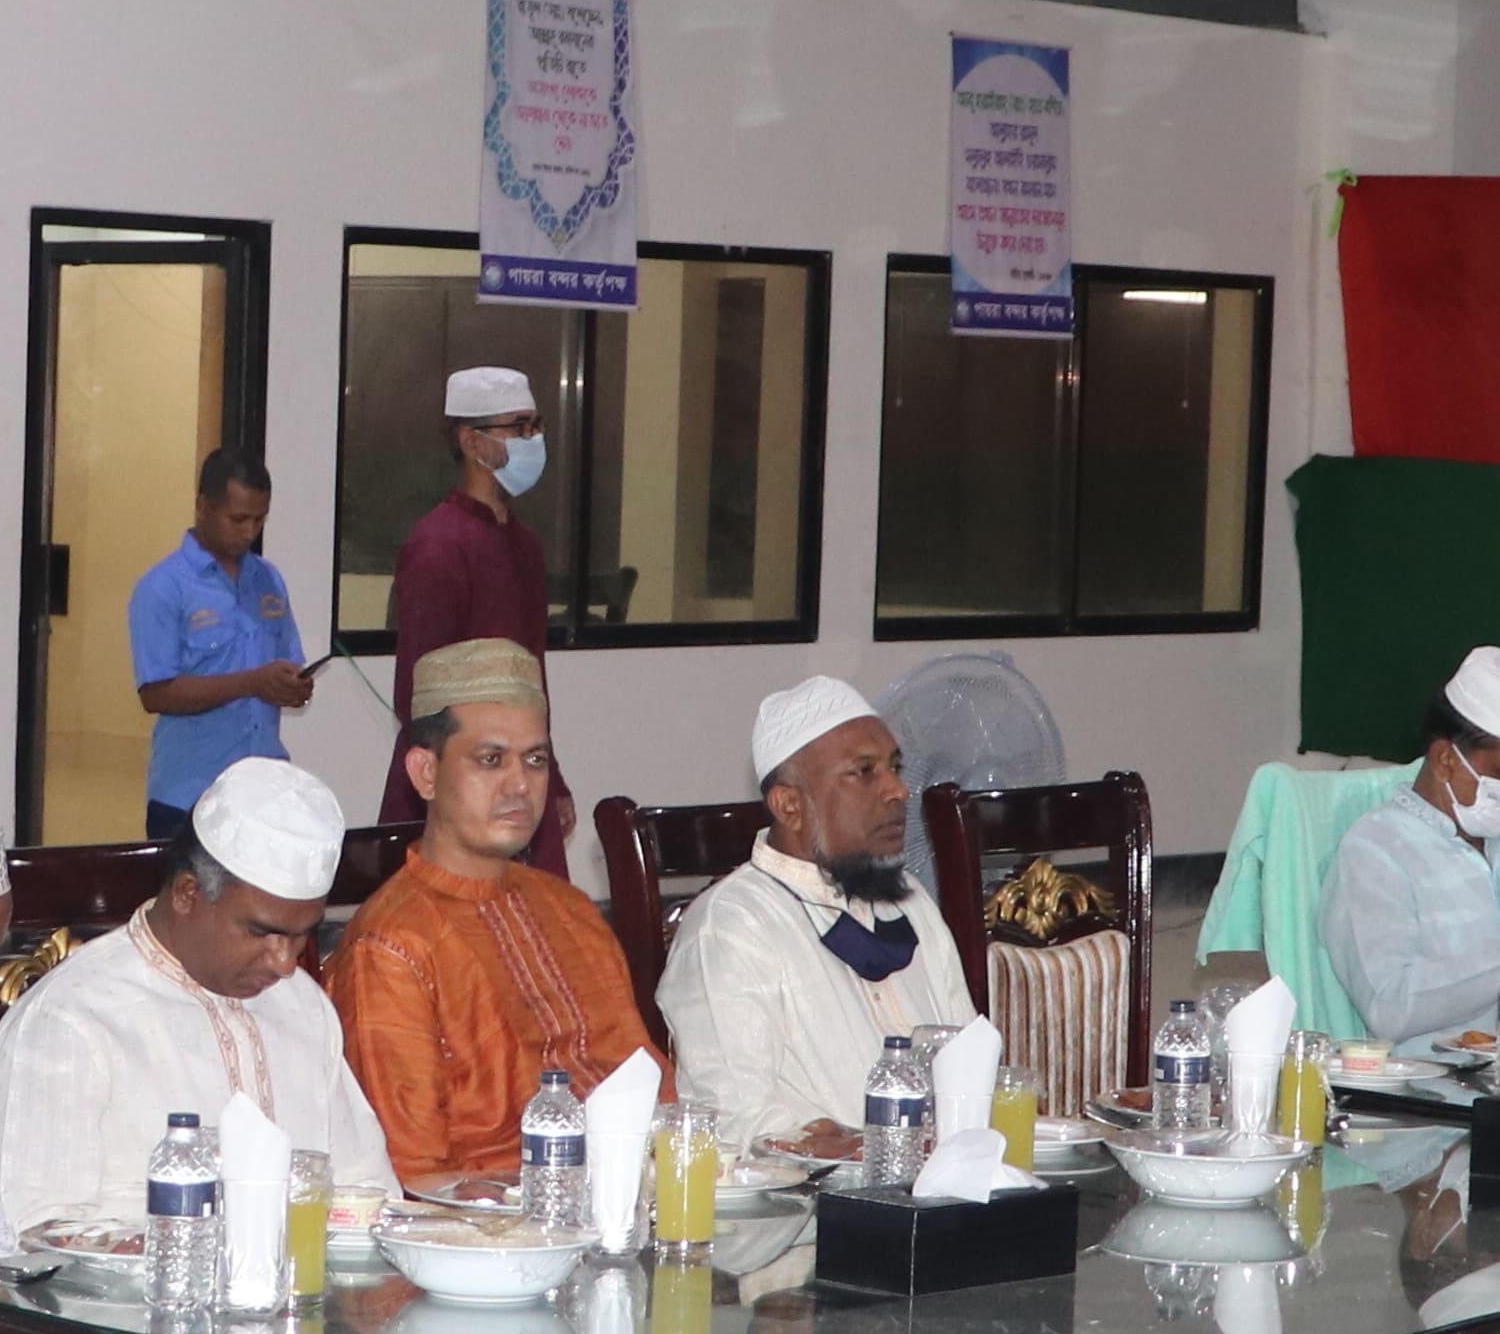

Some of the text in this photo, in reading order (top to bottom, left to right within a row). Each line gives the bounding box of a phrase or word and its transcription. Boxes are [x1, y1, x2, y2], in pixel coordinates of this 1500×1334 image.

[507, 267, 628, 297] পায়রা বন্দর কর্তৃপক্ষ
